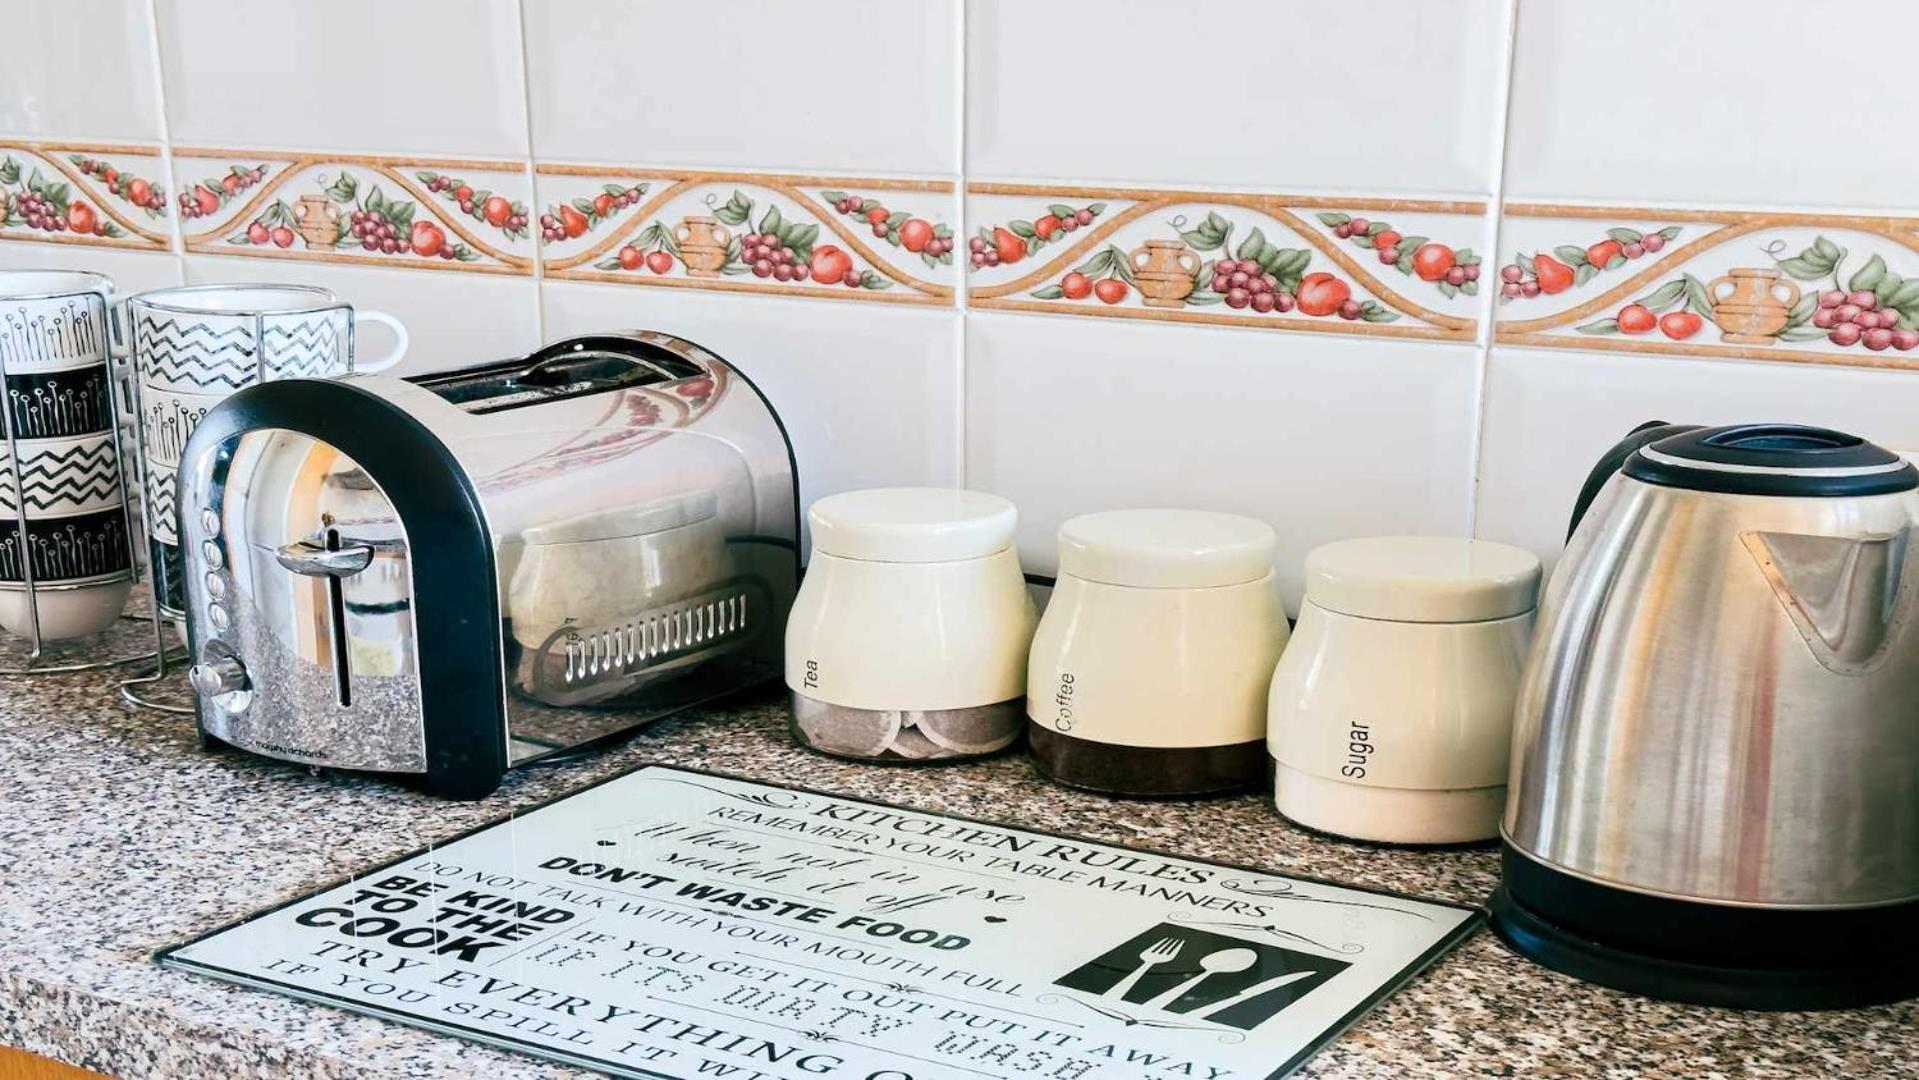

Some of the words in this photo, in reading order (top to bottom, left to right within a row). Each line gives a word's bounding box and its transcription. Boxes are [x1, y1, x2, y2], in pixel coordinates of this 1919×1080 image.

[804, 659, 818, 688] Tea
[1055, 673, 1074, 732] Coffee
[1341, 720, 1374, 778] Sugar
[706, 806, 882, 845] REMEMBER
[886, 837, 976, 862] YOUR
[984, 856, 1086, 883] TABLE
[1086, 876, 1276, 918] MANNERS
[809, 803, 1041, 854] KITCHEN
[1038, 844, 1217, 885] RULES
[869, 866, 921, 883] in
[295, 907, 508, 963] COOK
[345, 889, 419, 914] TO
[427, 907, 545, 941] THE
[373, 875, 449, 898] BE
[445, 890, 576, 925] KIND
[414, 862, 463, 876] DO
[464, 871, 537, 889] NOT
[537, 885, 617, 908] TALK
[618, 902, 708, 930] WITH
[710, 921, 801, 948] YOUR
[803, 940, 940, 977] MOUTH
[941, 969, 1024, 997] FULL
[537, 856, 677, 890] DON'T
[675, 882, 837, 924] WASTE
[836, 915, 971, 951] FOOD
[859, 893, 954, 914] off
[262, 959, 320, 976] IF
[331, 973, 436, 1003] YOU
[441, 1001, 595, 1046] SPILL
[612, 1041, 679, 1062] IT
[310, 940, 431, 974] TRY
[433, 968, 845, 1074] EVERYTHING
[526, 943, 597, 968] IF
[713, 984, 912, 1038] DIRTY
[934, 1031, 1102, 1080] WASH
[572, 930, 618, 946] IF
[620, 940, 706, 965] YOU
[708, 960, 790, 983] GET
[789, 977, 838, 993] IT
[842, 989, 935, 1014] OUT
[938, 1009, 1029, 1035] PUT
[1035, 1030, 1084, 1047] IT
[1088, 1044, 1233, 1080] AWAY
